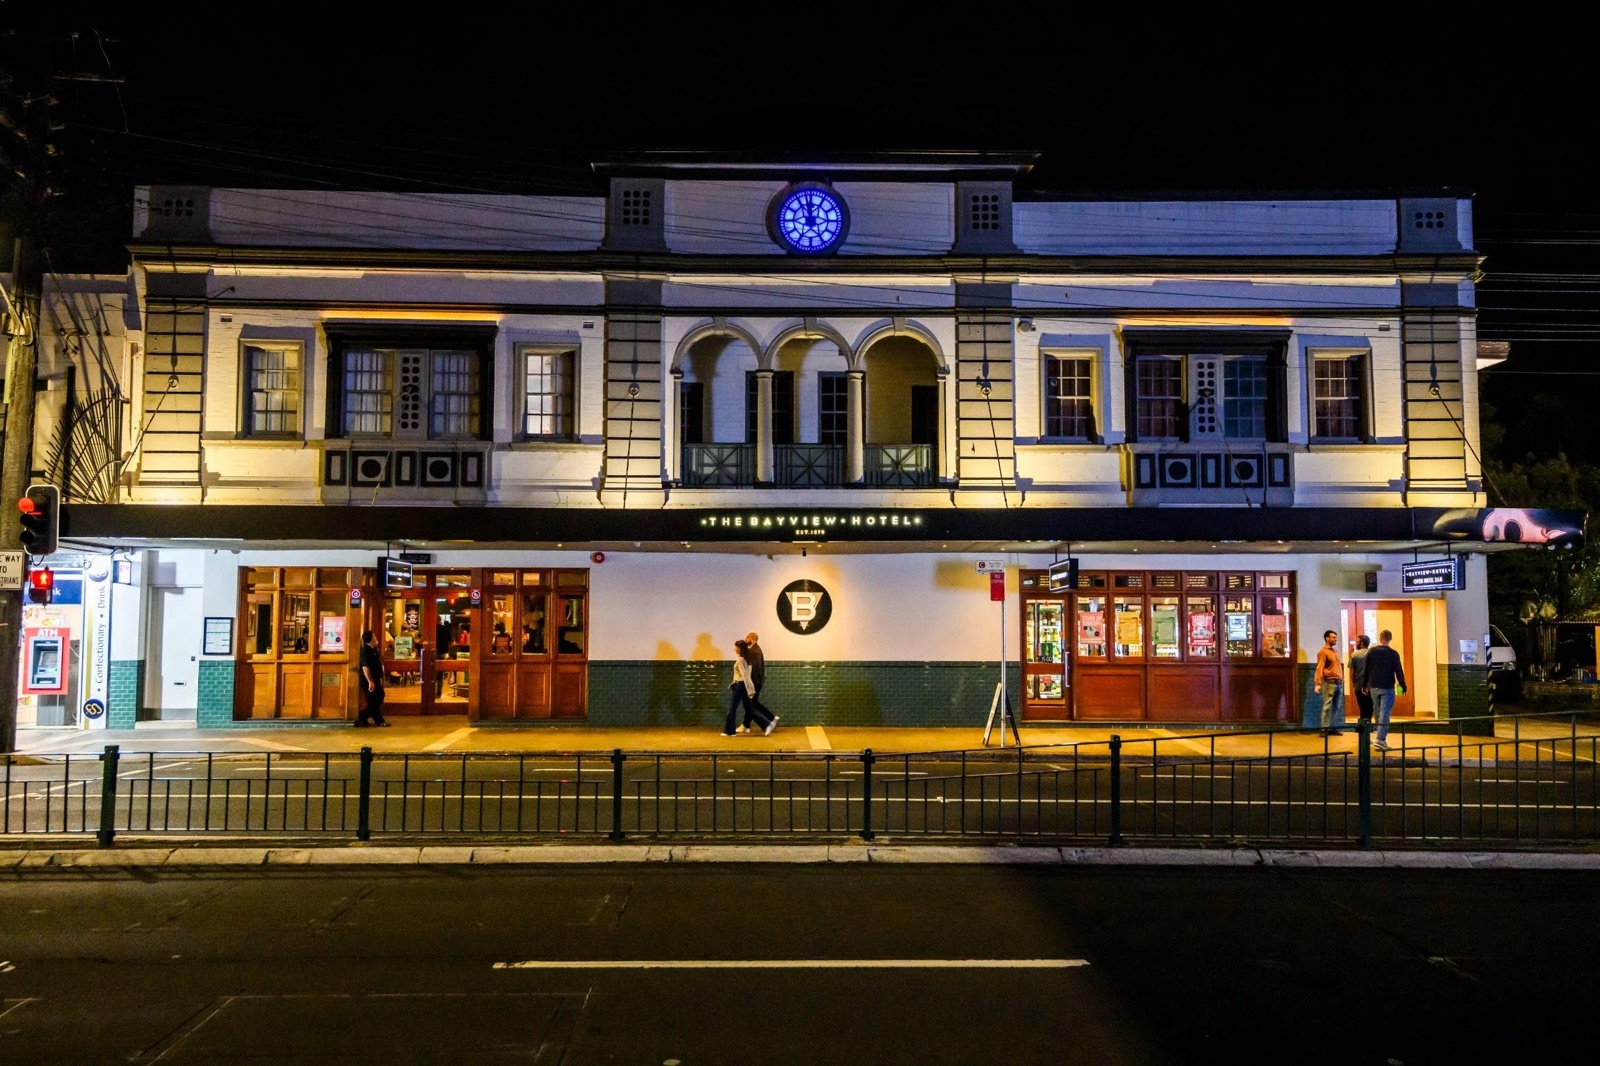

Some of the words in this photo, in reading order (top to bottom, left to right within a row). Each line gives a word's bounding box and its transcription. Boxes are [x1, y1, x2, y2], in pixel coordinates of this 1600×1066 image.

[709, 516, 742, 526] THE
[750, 516, 836, 526] BAYVIEW
[852, 516, 911, 526] HOTEL
[98, 586, 106, 609] Drink
[791, 591, 817, 621] B
[37, 628, 58, 637] ATM
[96, 623, 106, 684] Confectionary
